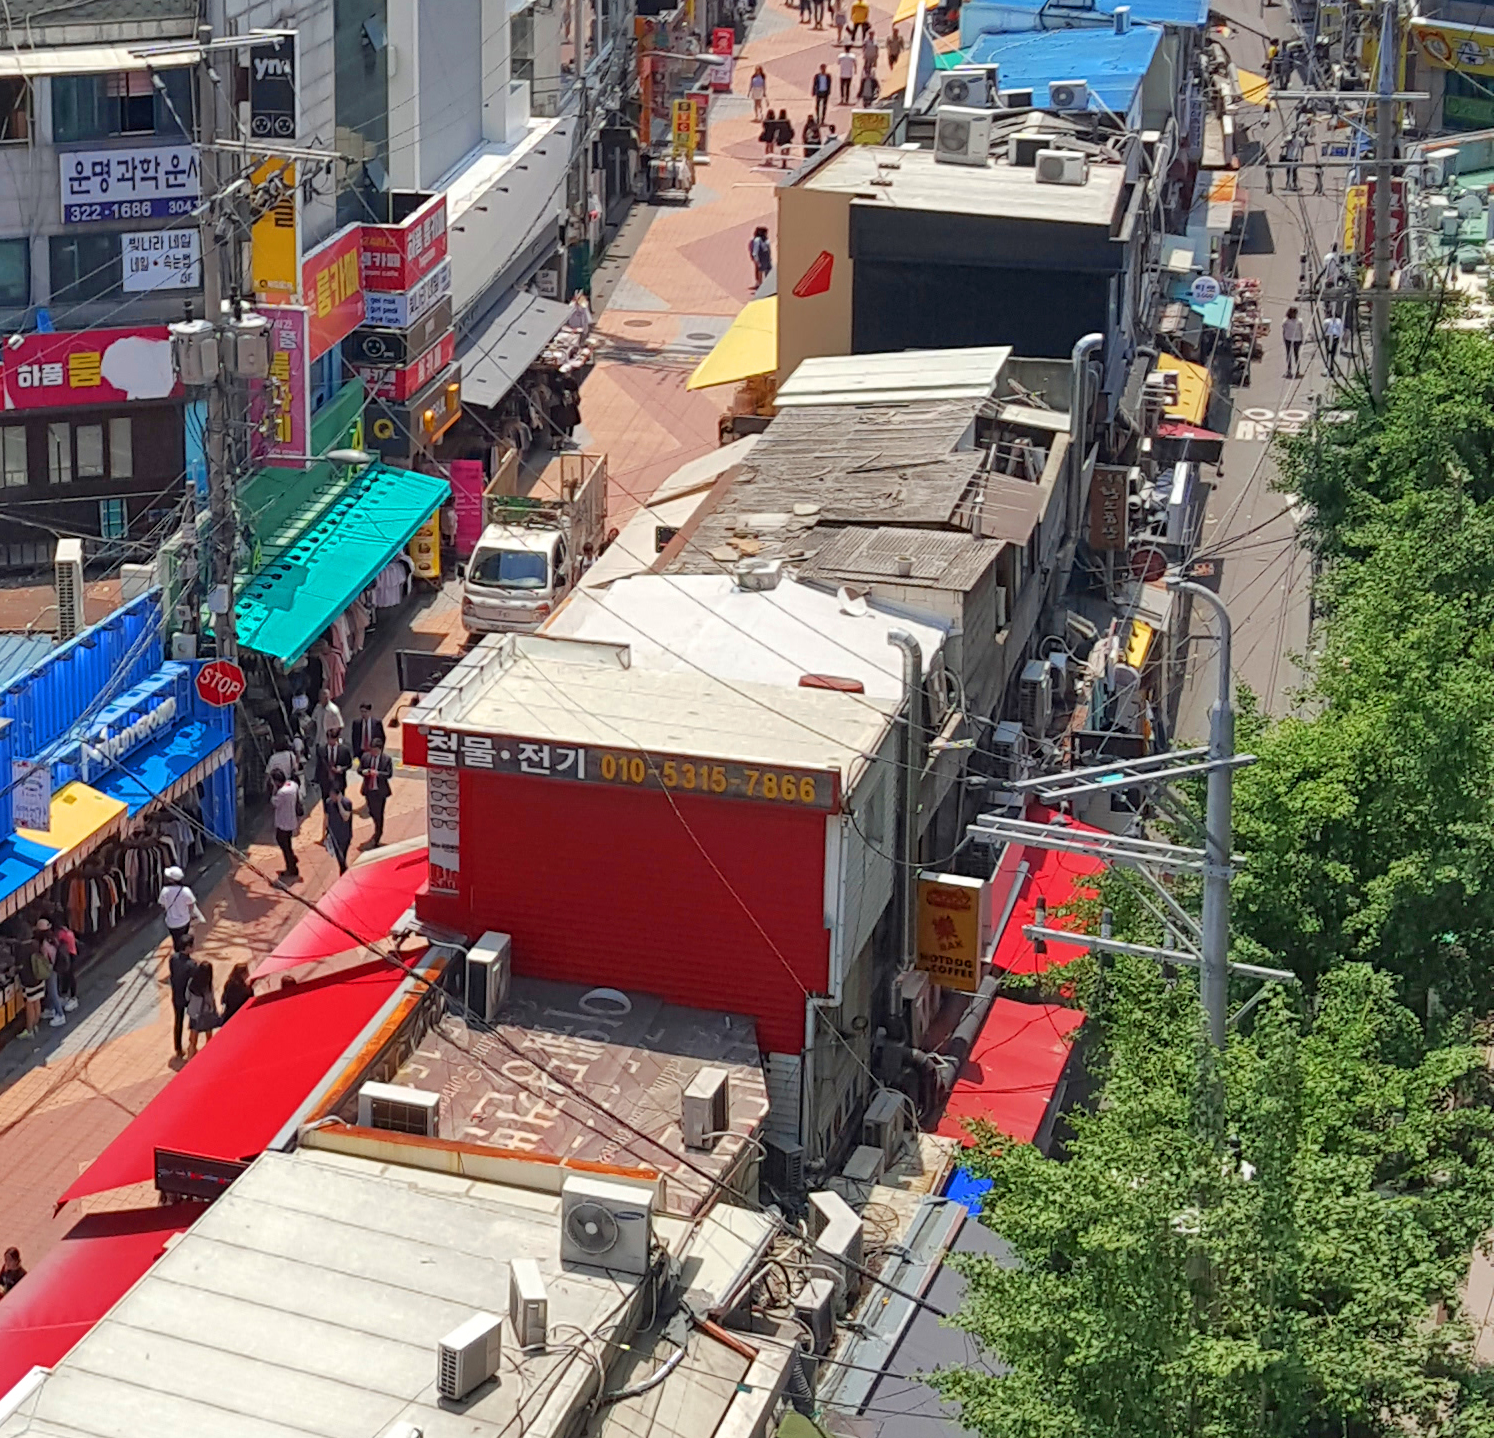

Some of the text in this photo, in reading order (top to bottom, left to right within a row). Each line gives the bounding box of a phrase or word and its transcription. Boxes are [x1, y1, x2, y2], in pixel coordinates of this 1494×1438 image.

[69, 158, 112, 195] 운명
[117, 155, 161, 191] 과학
[17, 362, 63, 388] 하품
[199, 668, 241, 696] STOP
[600, 752, 817, 803] 010-5315-7866
